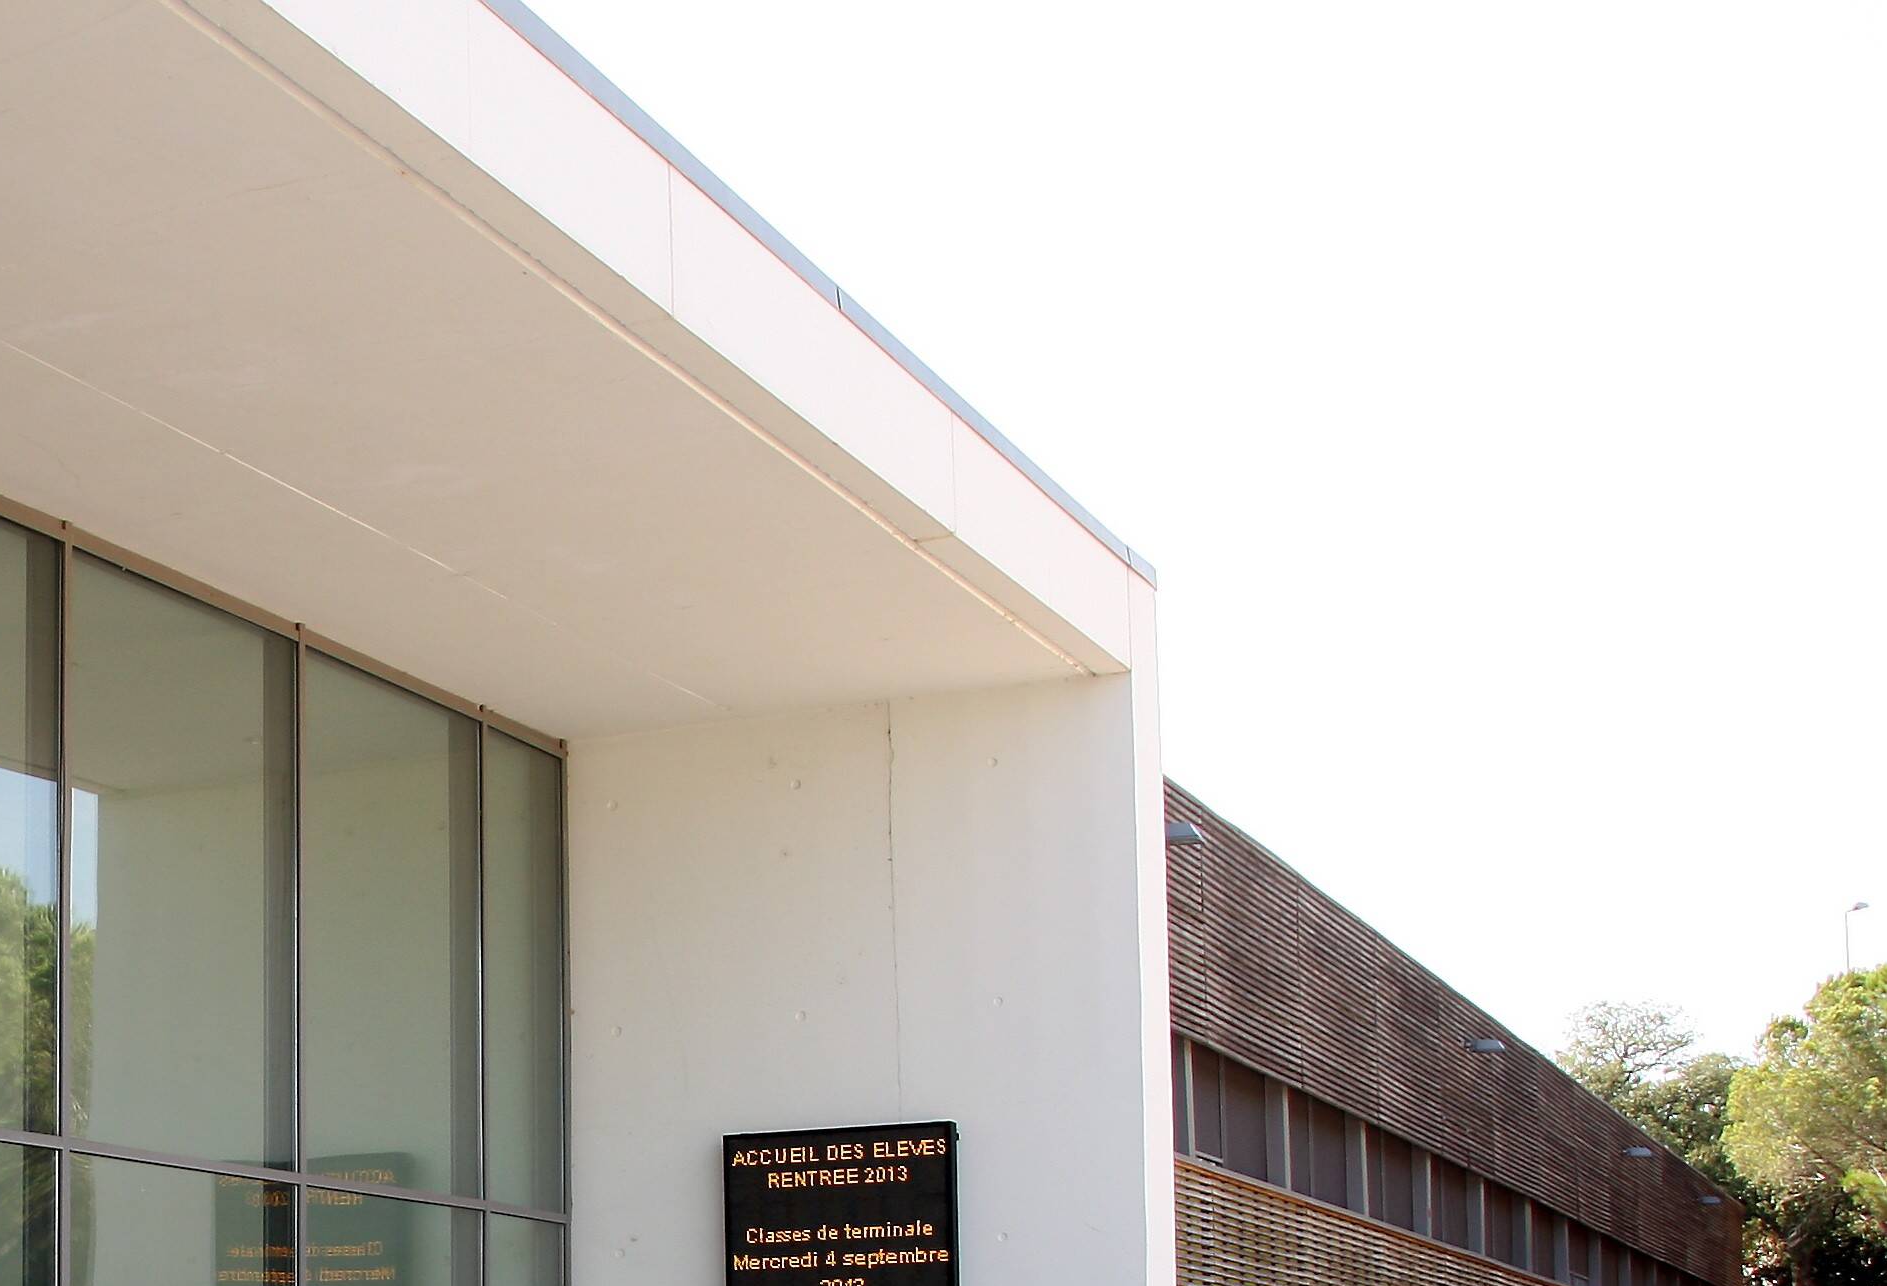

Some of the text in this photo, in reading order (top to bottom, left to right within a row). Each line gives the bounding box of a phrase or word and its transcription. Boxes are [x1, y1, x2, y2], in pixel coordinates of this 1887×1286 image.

[732, 1139, 946, 1166] ACCUEIL DES ELEVES
[768, 1166, 908, 1188] RENTREE 2013
[746, 1220, 933, 1244] Classes de terminale
[733, 1247, 949, 1270] Mercredi 4 septembre
